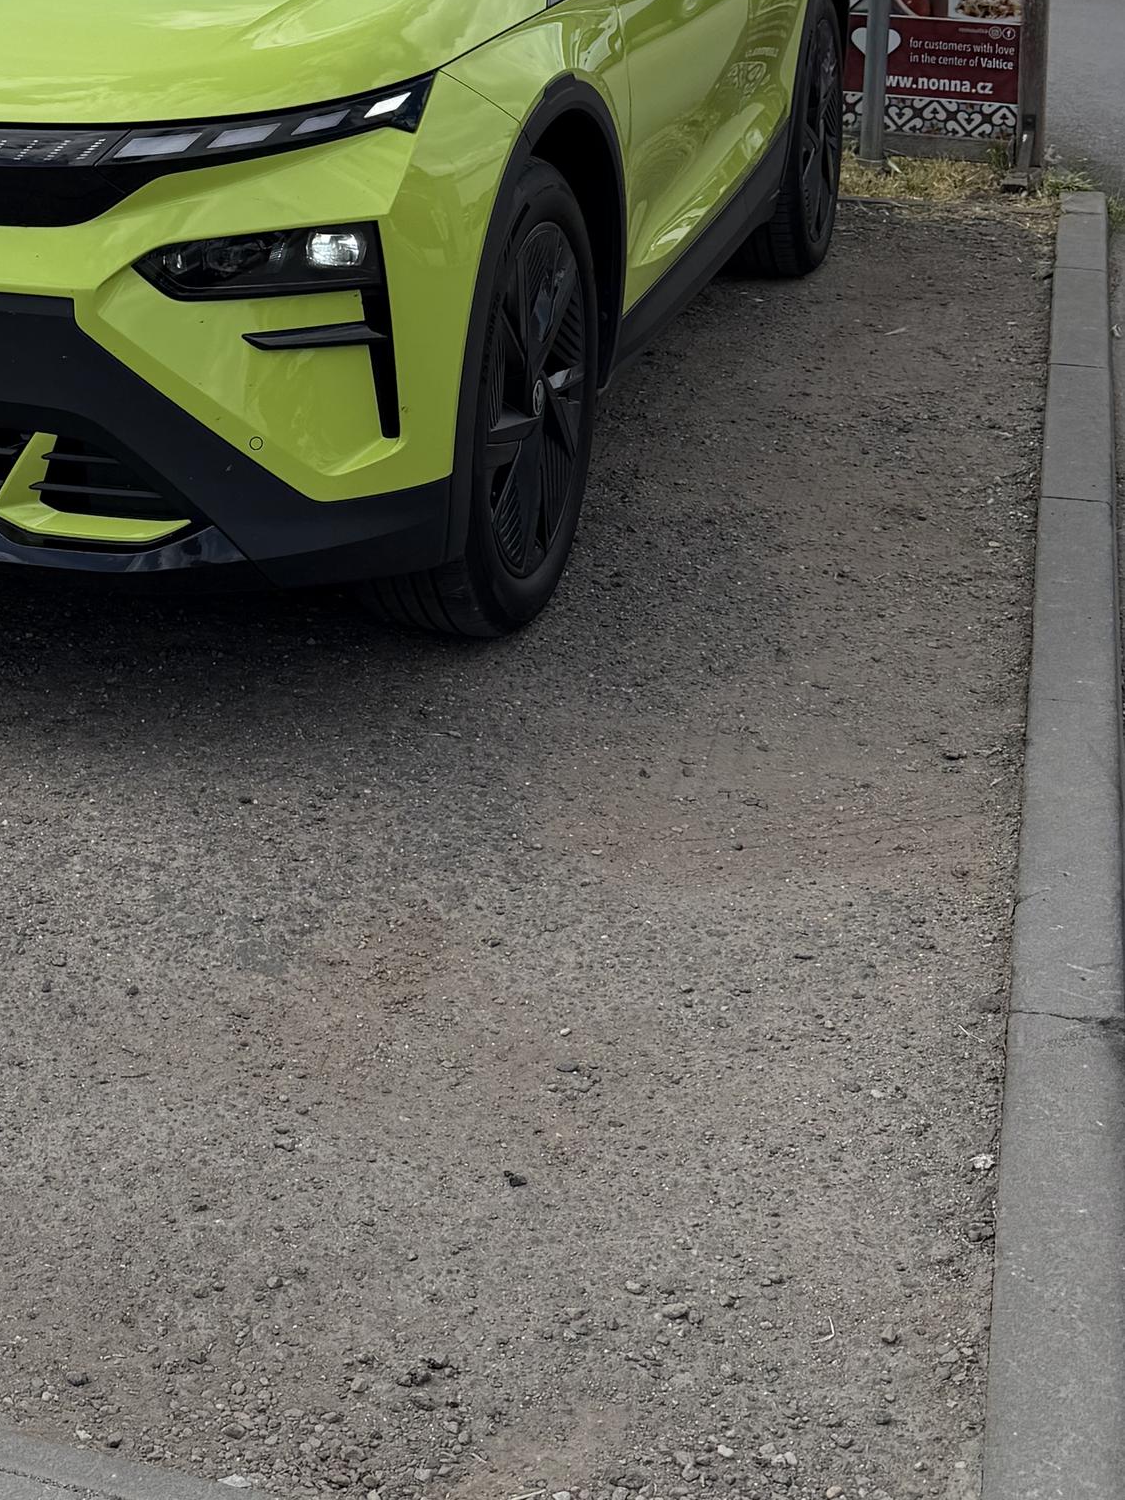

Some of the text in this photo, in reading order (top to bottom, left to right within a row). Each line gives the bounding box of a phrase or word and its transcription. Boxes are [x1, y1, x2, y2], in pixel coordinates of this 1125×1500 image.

[909, 37, 1015, 56] for customers with love
[909, 52, 1014, 70] in the center of Valtice
[885, 74, 994, 95] ww.nonna.cz
